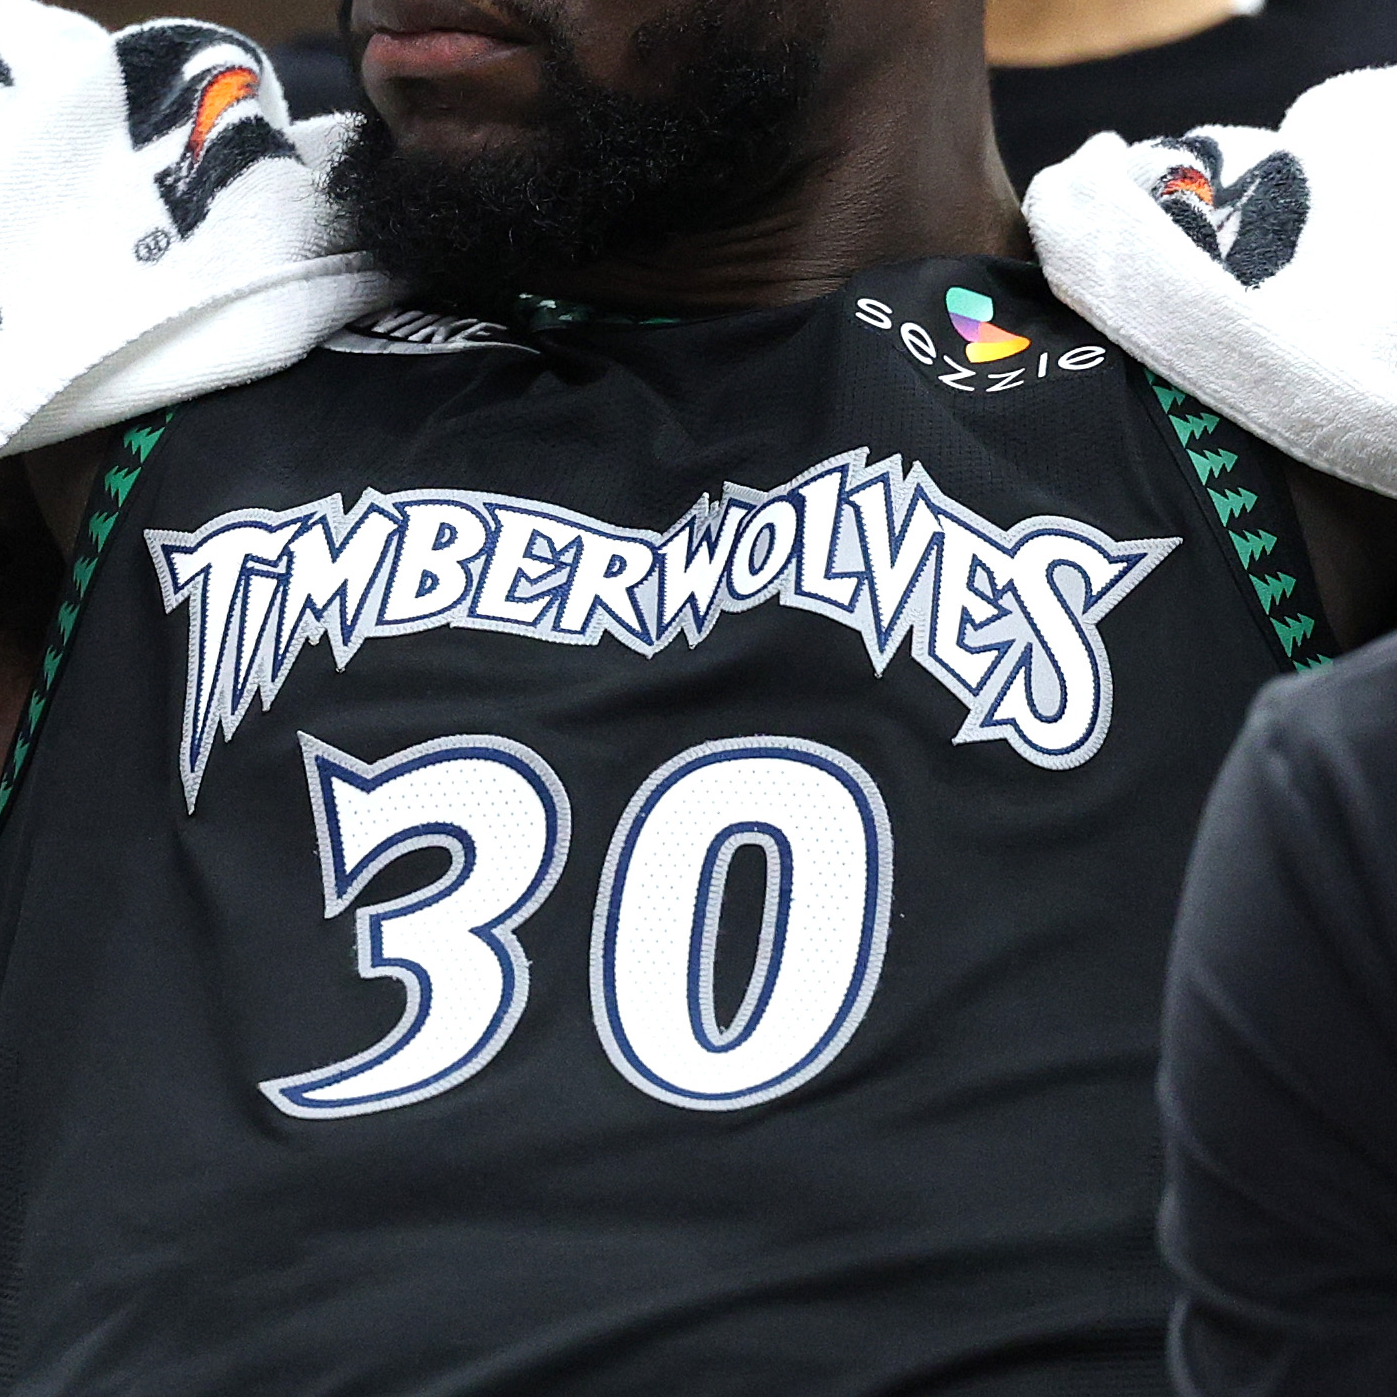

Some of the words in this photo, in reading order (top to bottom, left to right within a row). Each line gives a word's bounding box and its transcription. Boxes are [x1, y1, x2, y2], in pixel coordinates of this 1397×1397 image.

[855, 297, 1106, 393] sezzle
[143, 445, 1183, 816] TIMBERWOLVES
[258, 730, 895, 1120] 30
